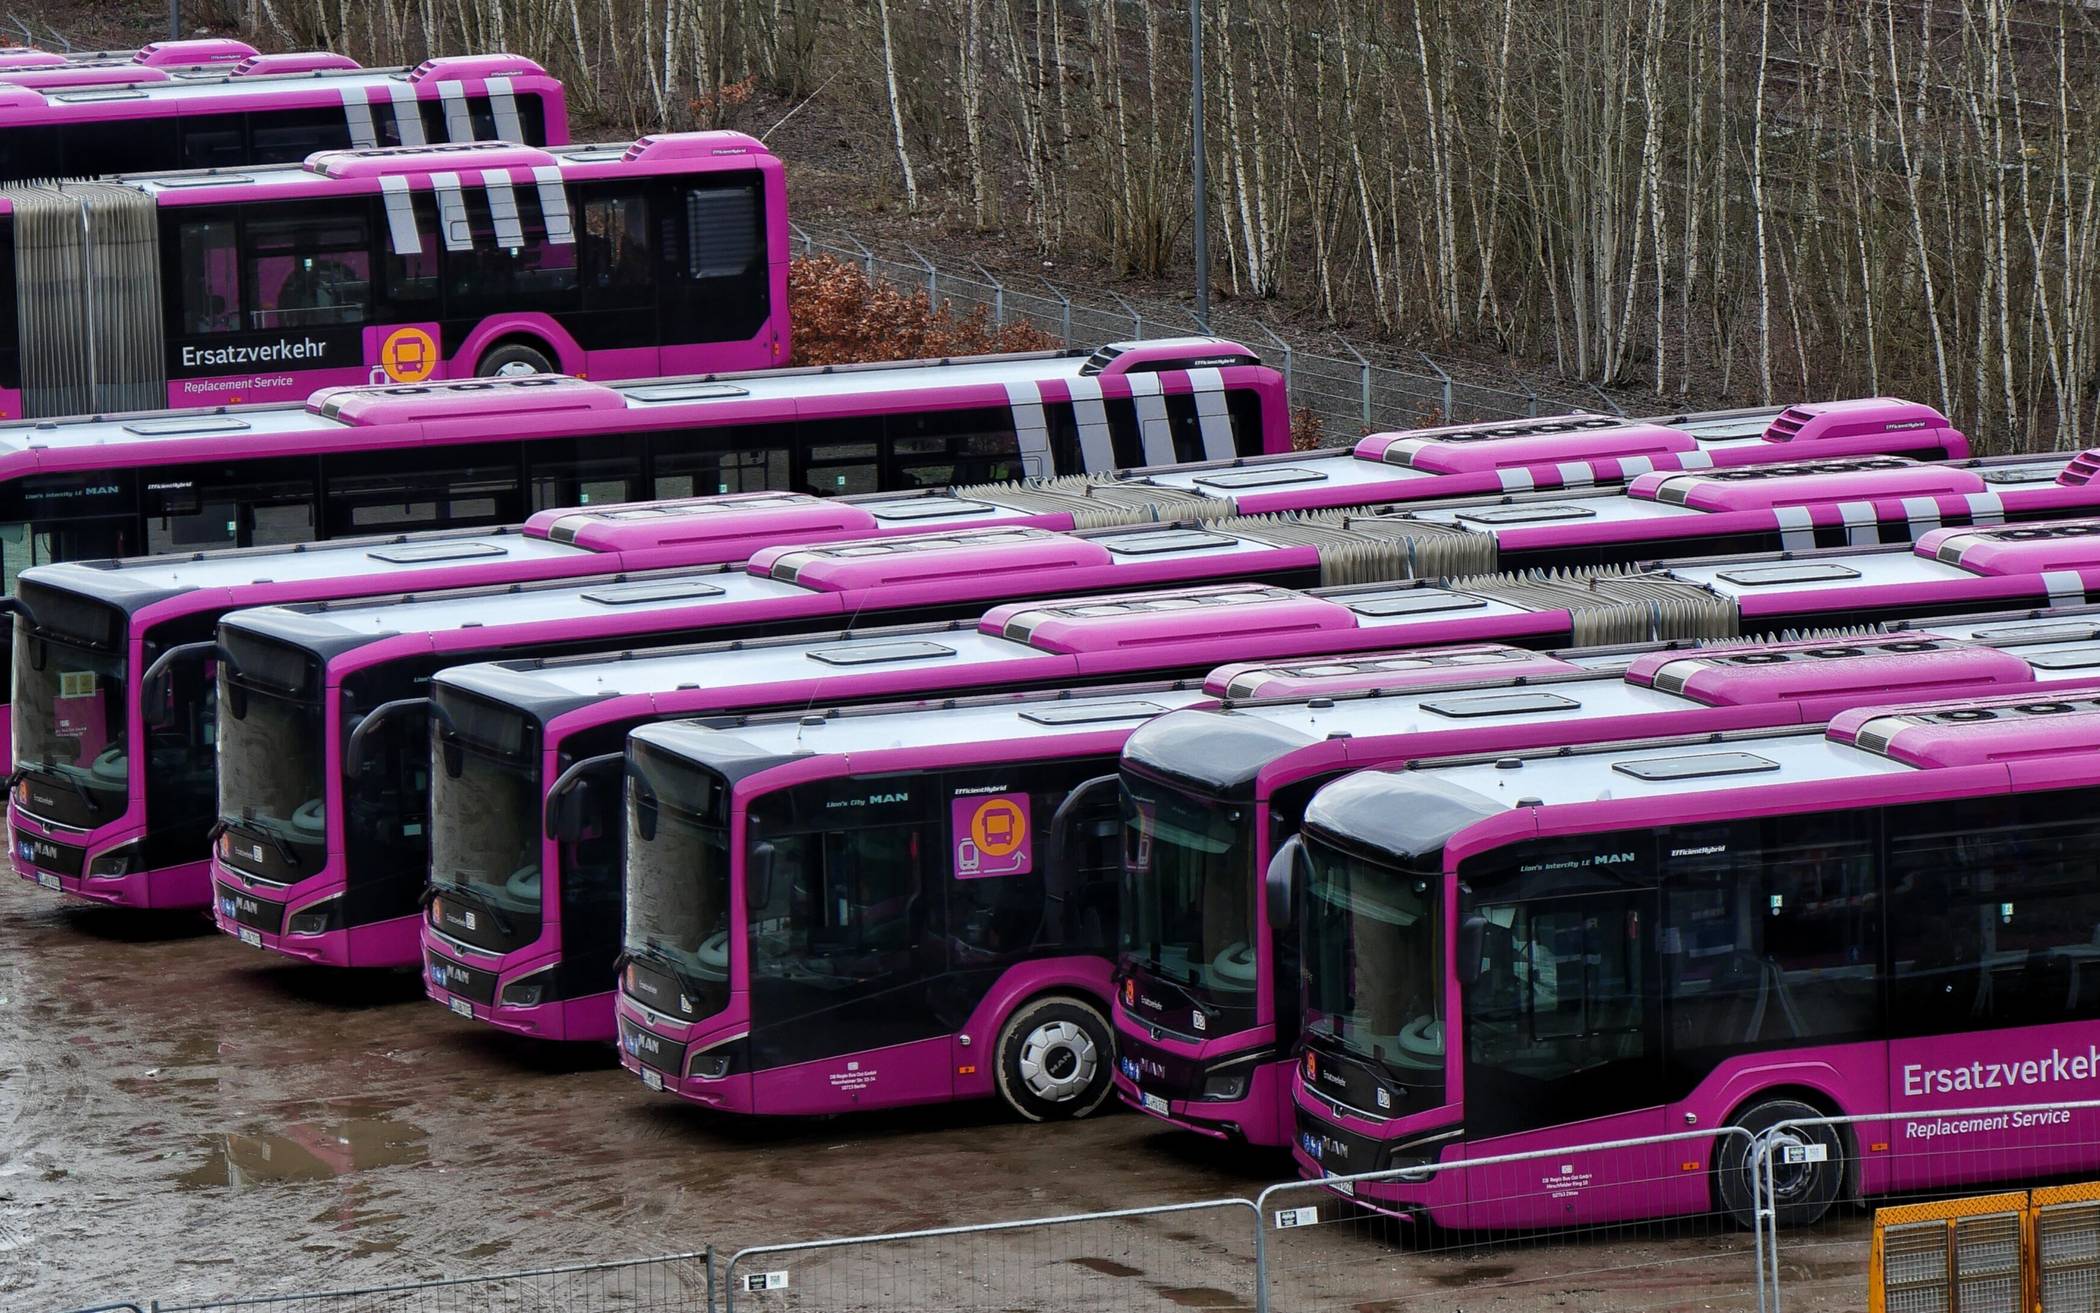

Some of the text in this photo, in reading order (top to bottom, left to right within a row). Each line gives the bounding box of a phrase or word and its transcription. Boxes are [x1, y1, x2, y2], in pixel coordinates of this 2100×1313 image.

[182, 337, 326, 366] Ersatzverkehr
[184, 376, 293, 393] Replacement Service
[85, 485, 119, 495] MAN
[954, 785, 1007, 795] EfficientHybrid
[826, 793, 909, 808] Lion's City MAN
[34, 841, 57, 859] MAN
[1671, 845, 1726, 857] EfficientHybrid
[1520, 852, 1635, 872] Lion's Intercity LE MAN
[236, 896, 258, 915] MAN
[446, 965, 469, 985] MAN
[638, 1033, 659, 1055] MAN
[1050, 1051, 1072, 1073] MAN
[1141, 1058, 1165, 1079] MAN
[1378, 1087, 1390, 1108] DB
[1906, 1109, 2071, 1139] Replacement Service
[1322, 1135, 1348, 1158] MAN
